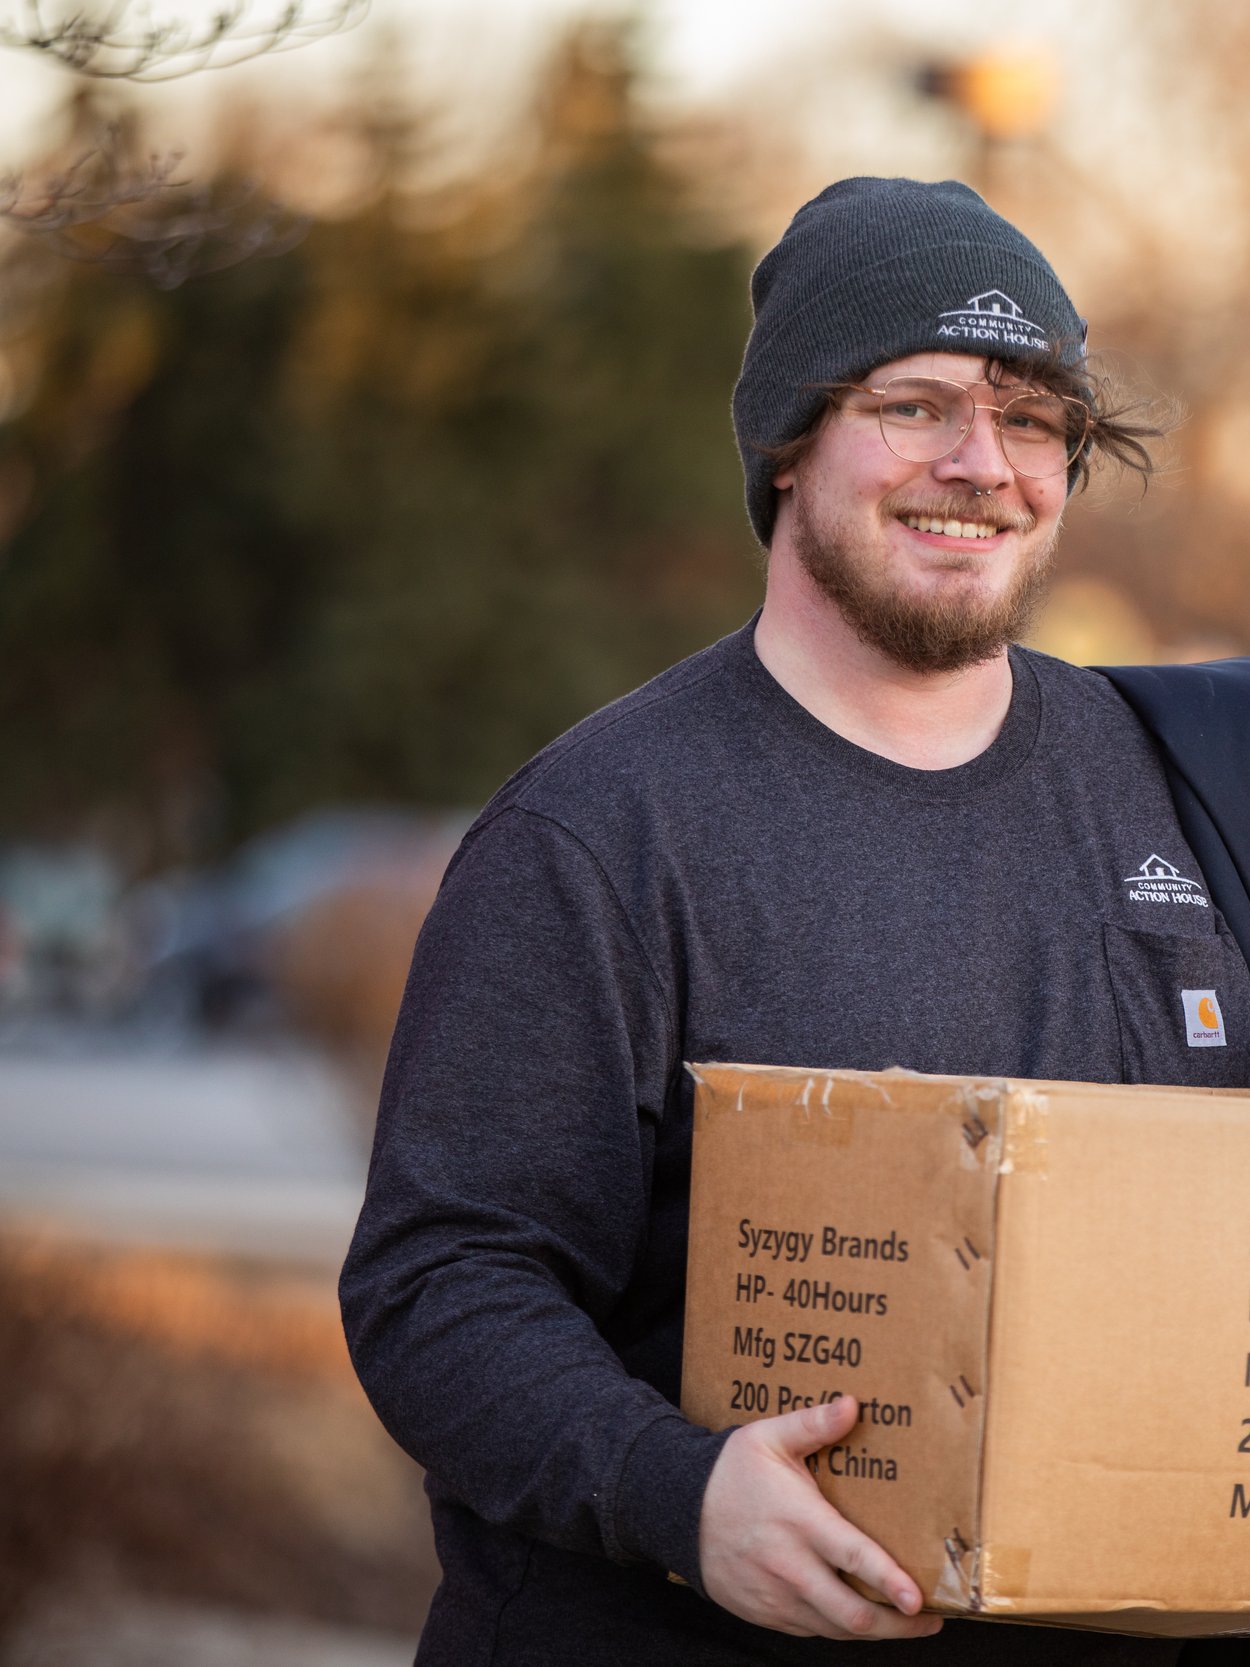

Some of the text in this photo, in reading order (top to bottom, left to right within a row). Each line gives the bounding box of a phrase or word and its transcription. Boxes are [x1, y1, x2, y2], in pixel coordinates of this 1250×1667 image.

[937, 325, 1050, 351] ACTION HOUSE
[959, 317, 1031, 332] COMMUNITY
[1129, 889, 1209, 908] ACTION HOUSE
[1138, 882, 1192, 892] COMMUNITY
[738, 1218, 909, 1263] Syzygy Brands
[735, 1273, 888, 1316] HP- 40Hours
[733, 1326, 862, 1368] Mfg SZG40
[730, 1380, 912, 1427] 200 Pcsrton
[828, 1445, 897, 1481] China
